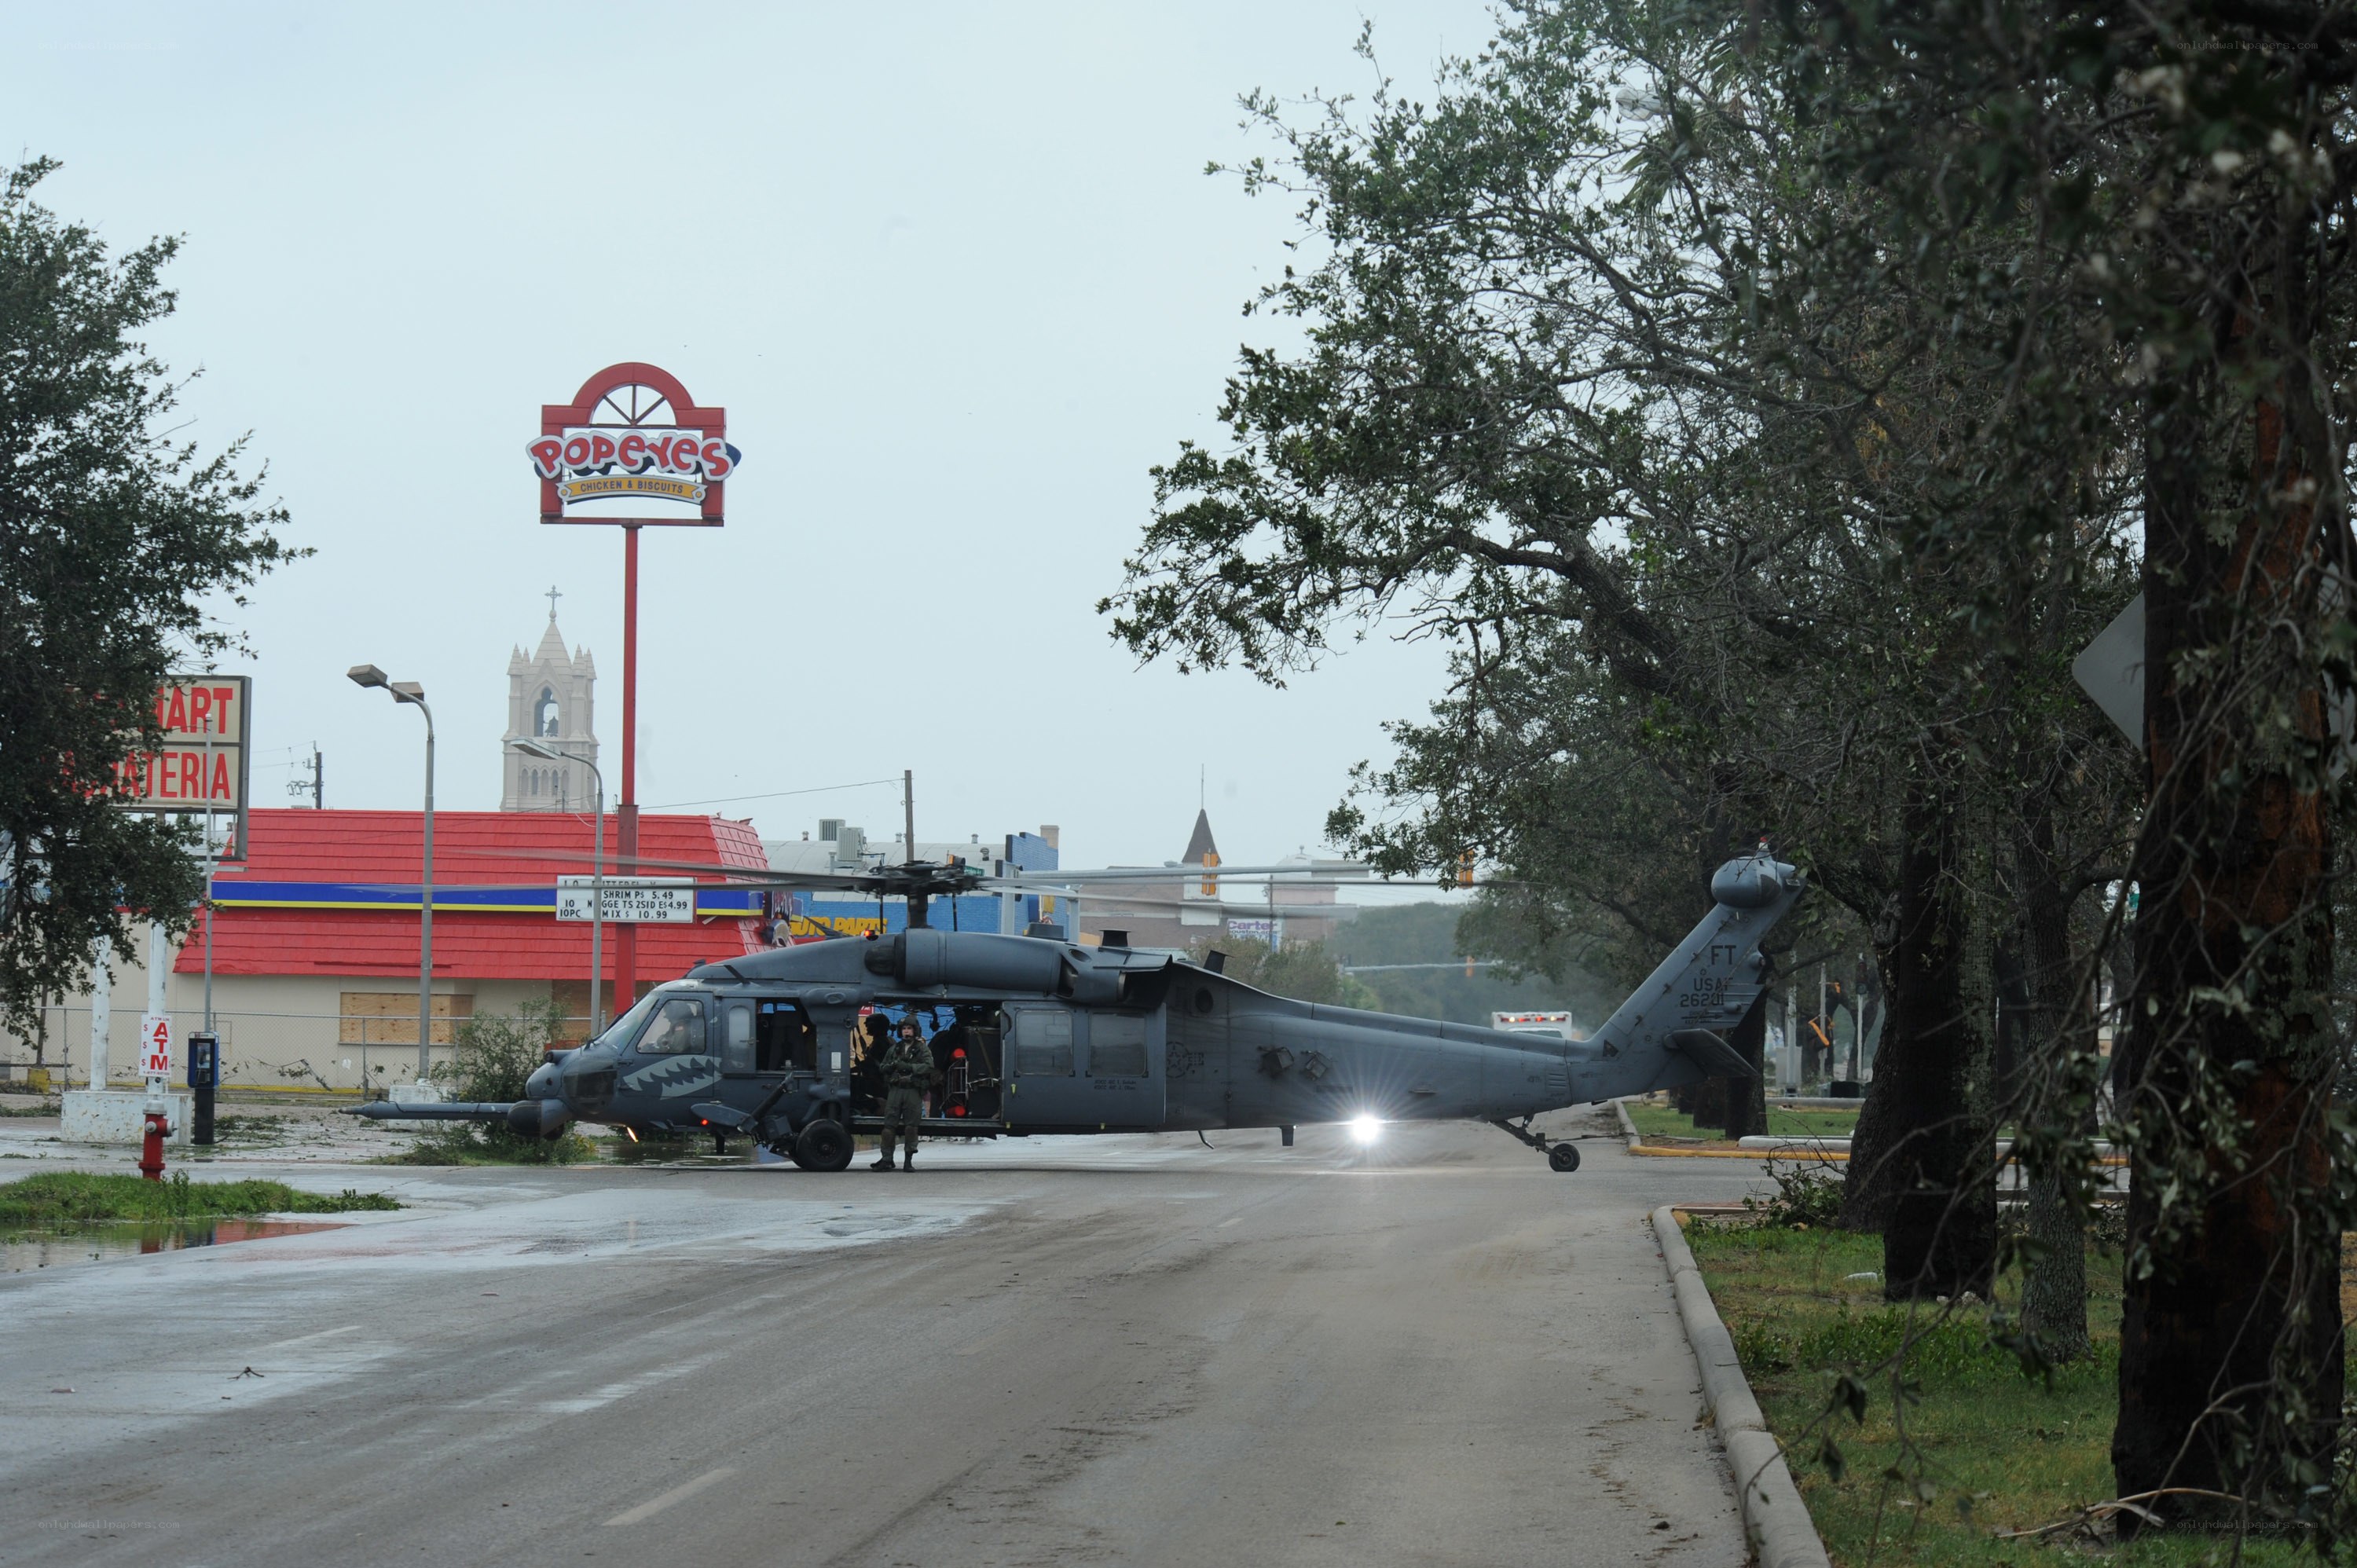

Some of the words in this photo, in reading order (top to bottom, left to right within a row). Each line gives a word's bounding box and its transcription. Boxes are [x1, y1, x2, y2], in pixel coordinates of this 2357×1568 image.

[580, 482, 623, 493] CHICKEN
[637, 482, 684, 494] BISCUITS
[651, 891, 674, 900] 5.49
[1710, 945, 1737, 965] FT
[1693, 977, 1733, 991] USAF
[150, 1023, 168, 1071] ATM
